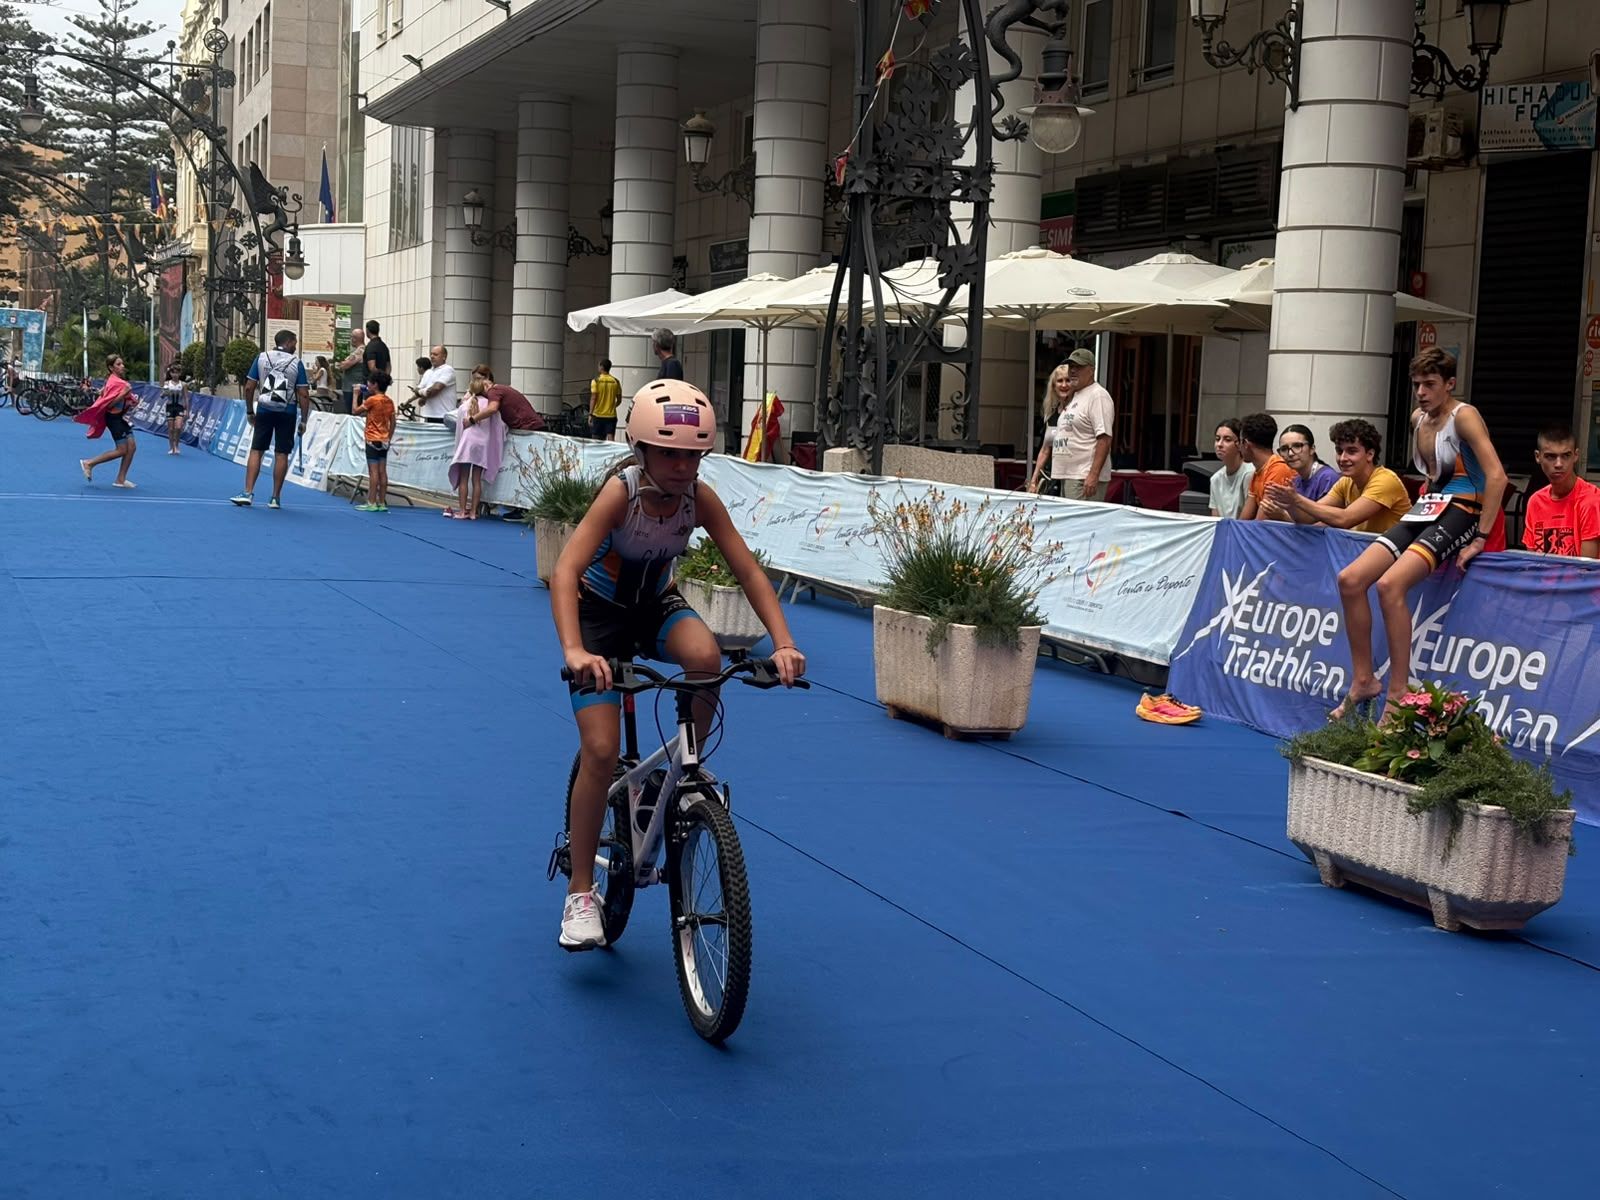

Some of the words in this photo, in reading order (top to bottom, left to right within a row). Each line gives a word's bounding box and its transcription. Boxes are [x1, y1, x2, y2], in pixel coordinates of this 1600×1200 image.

[1515, 103, 1556, 122] FON
[1421, 327, 1435, 343] ria
[1420, 503, 1436, 515] 57
[1117, 579, 1146, 596] Ceuta
[1156, 575, 1196, 598] Deporte
[1234, 588, 1340, 649] Europe
[1223, 633, 1346, 702] Triathlon
[1414, 623, 1547, 691] Europe
